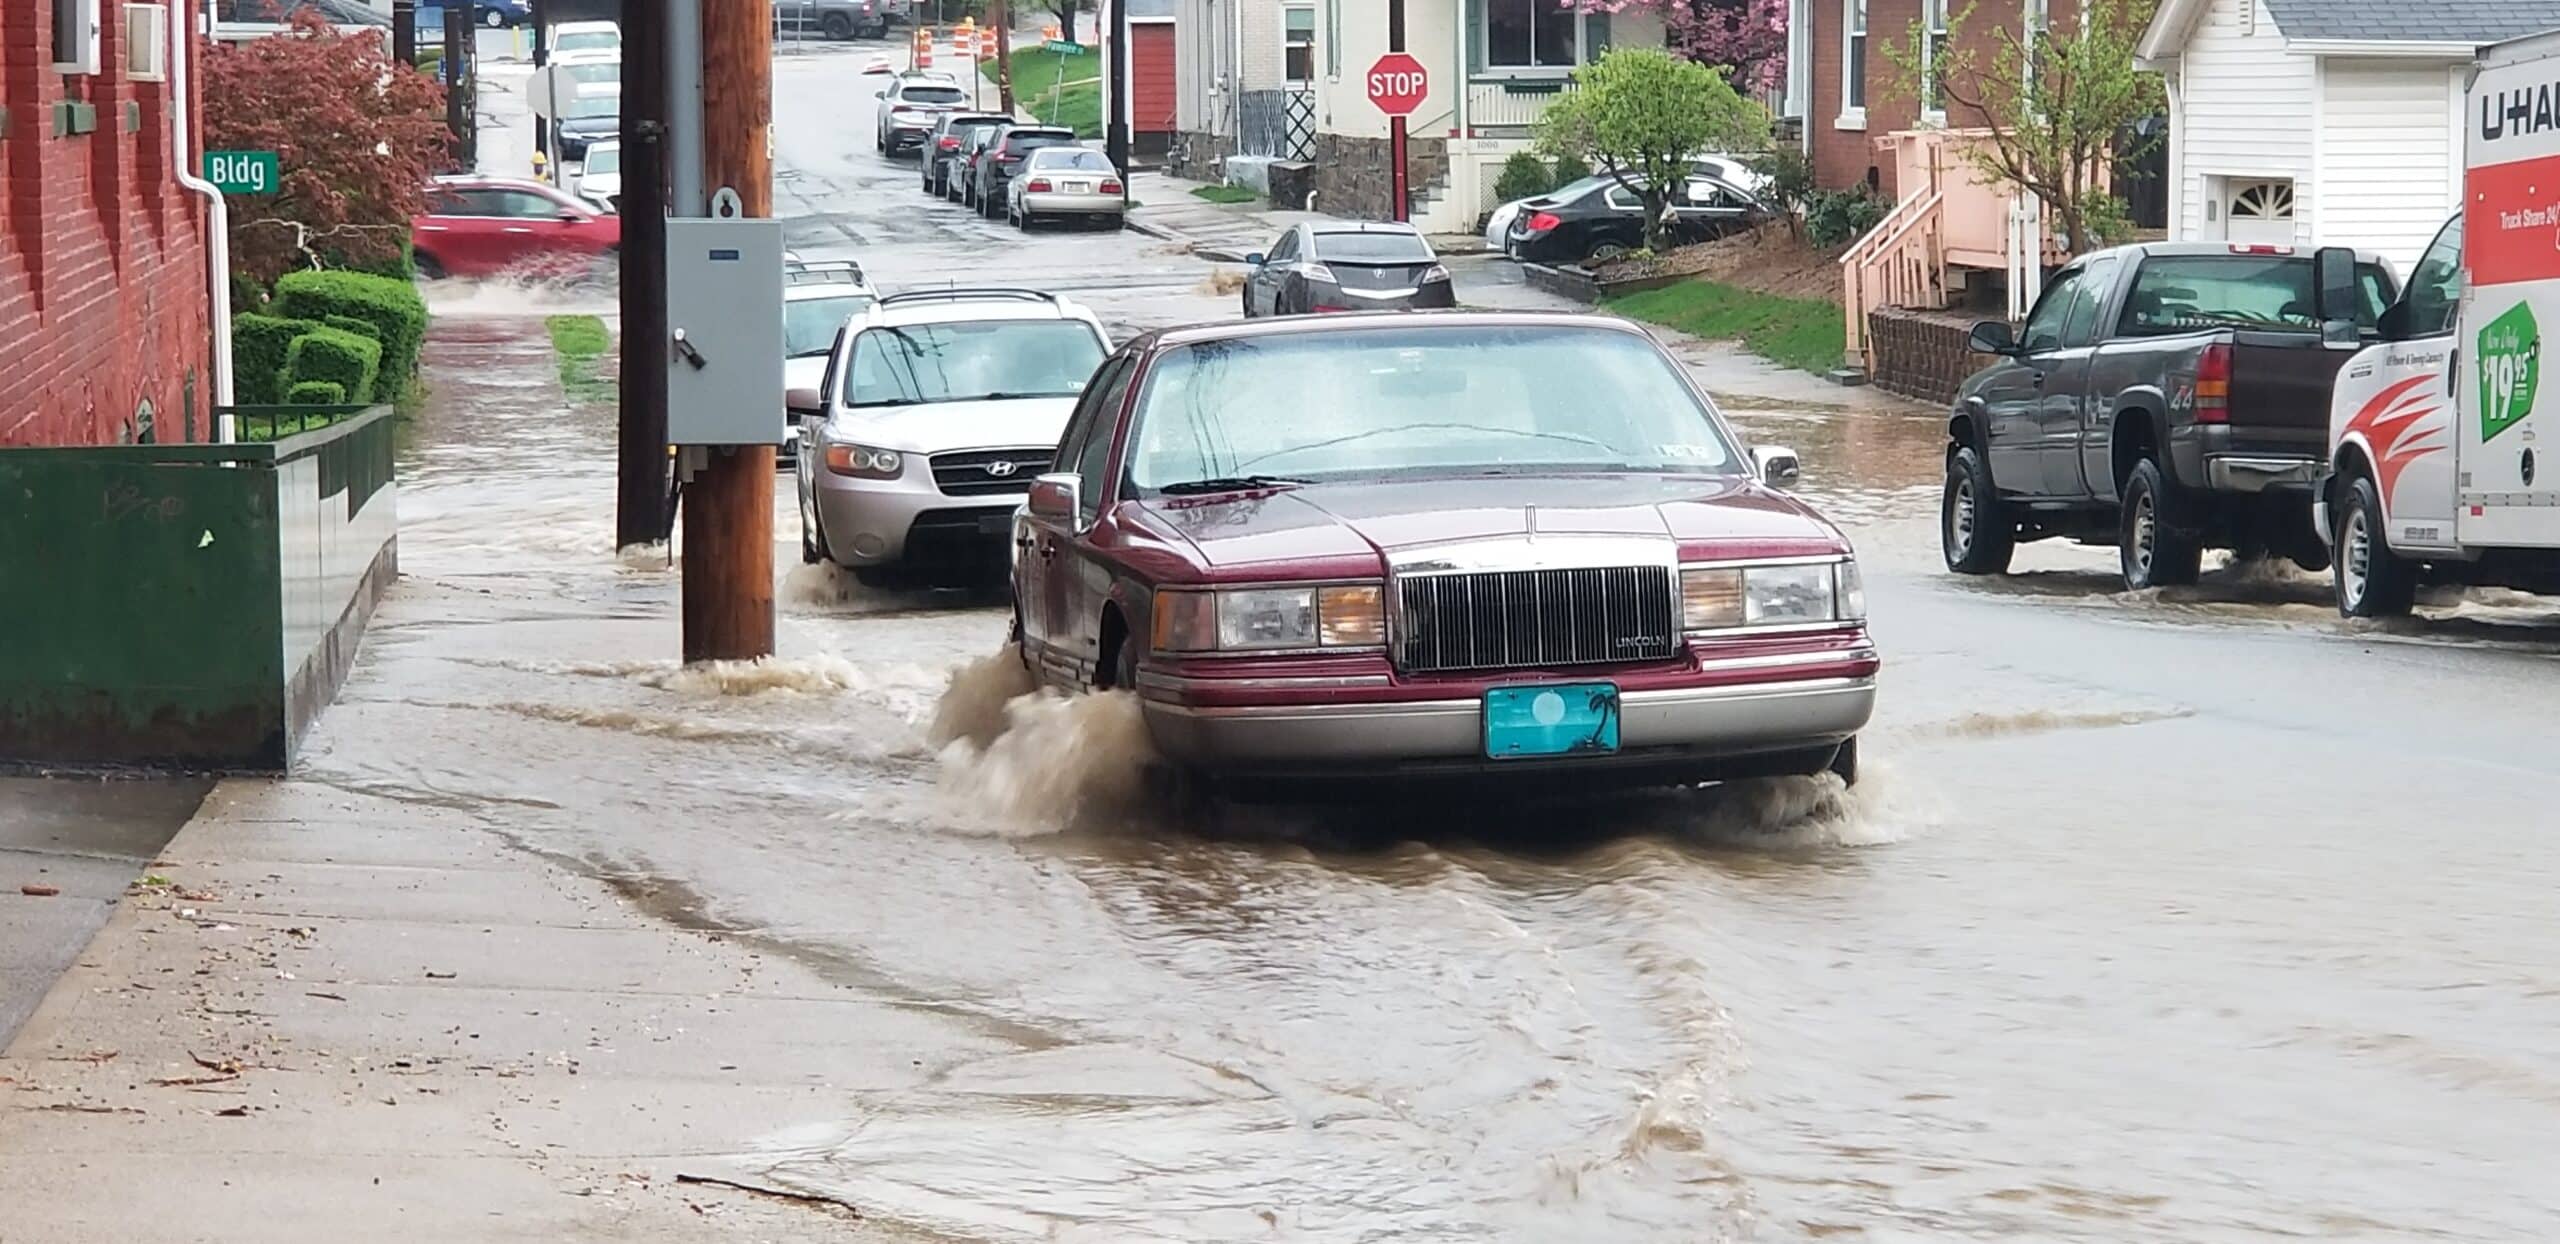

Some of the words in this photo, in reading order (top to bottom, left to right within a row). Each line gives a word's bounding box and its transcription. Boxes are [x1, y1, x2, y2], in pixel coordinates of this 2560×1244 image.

[1371, 72, 1424, 97] STOP
[2482, 81, 2560, 141] U-HA
[212, 155, 264, 191] Bldg
[2501, 210, 2522, 230] Truck
[2523, 207, 2546, 227] Share
[1616, 635, 1664, 648] LINCOLN
